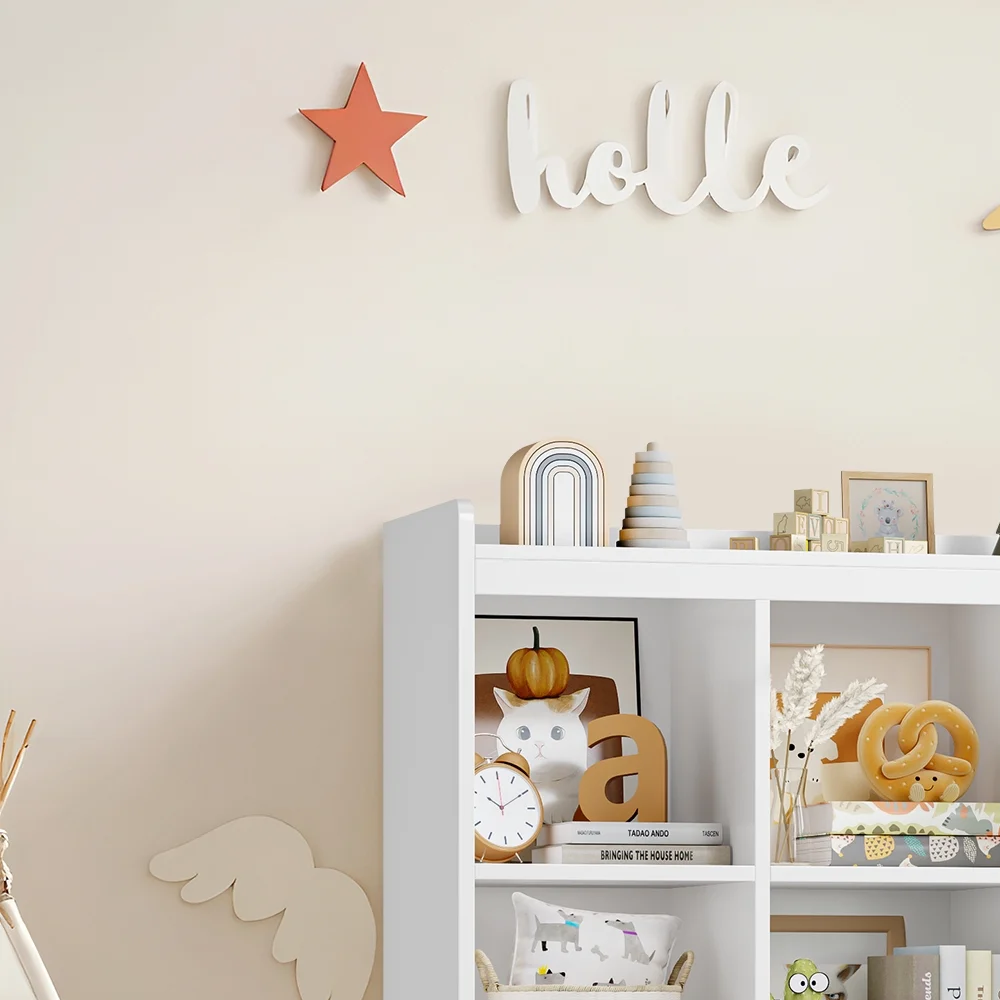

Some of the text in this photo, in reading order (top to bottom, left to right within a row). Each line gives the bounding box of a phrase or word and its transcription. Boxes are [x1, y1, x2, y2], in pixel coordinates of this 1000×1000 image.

[507, 79, 832, 215] holle
[579, 714, 668, 822] a
[600, 850, 694, 861] BRINGING THE HOUSE HOME
[628, 829, 669, 837] TADAO ANDO
